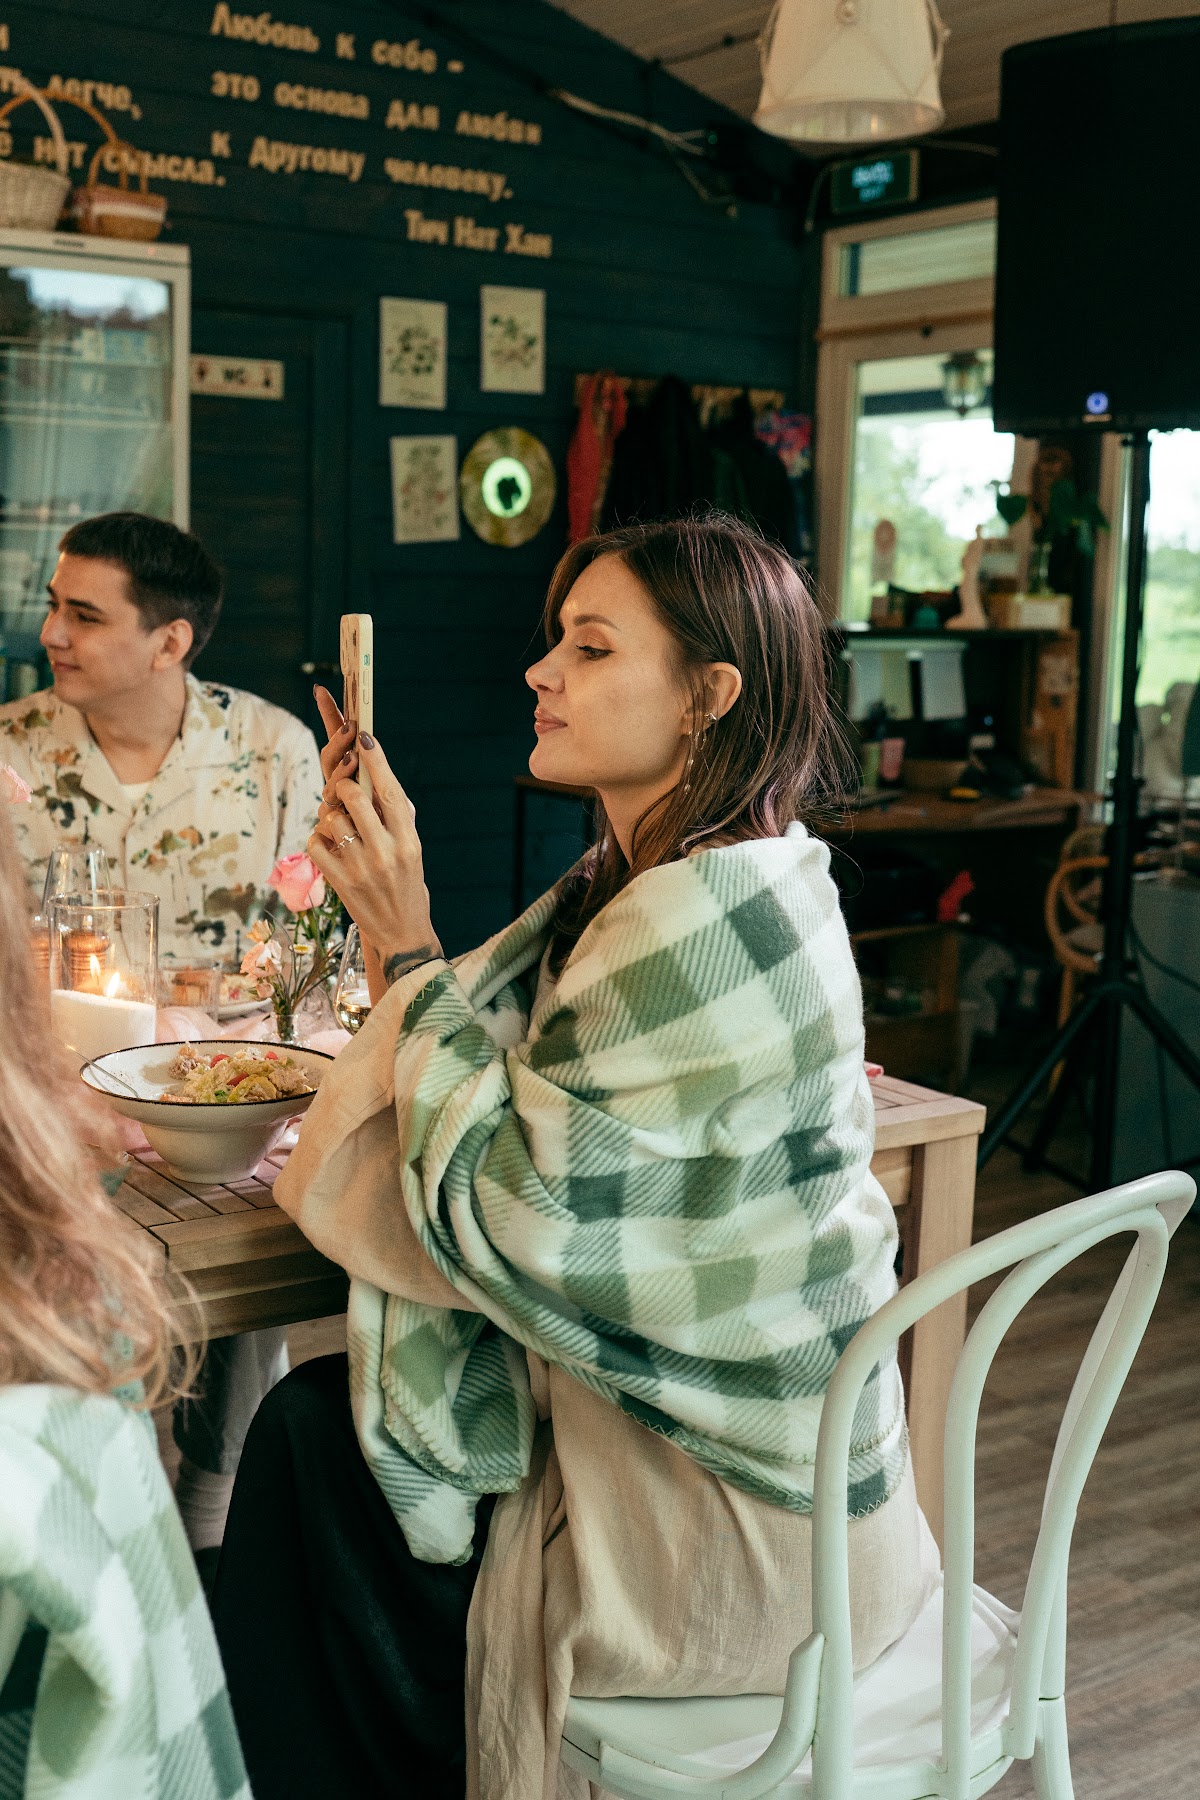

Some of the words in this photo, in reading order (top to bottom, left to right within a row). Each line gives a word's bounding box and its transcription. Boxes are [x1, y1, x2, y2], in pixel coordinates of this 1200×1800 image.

[209, 1, 321, 53] Любовь
[370, 38, 438, 74] себе
[210, 70, 261, 102] это
[273, 82, 370, 120] основа
[455, 110, 542, 146] любви
[33, 135, 89, 170] нт
[403, 208, 449, 246] Тич
